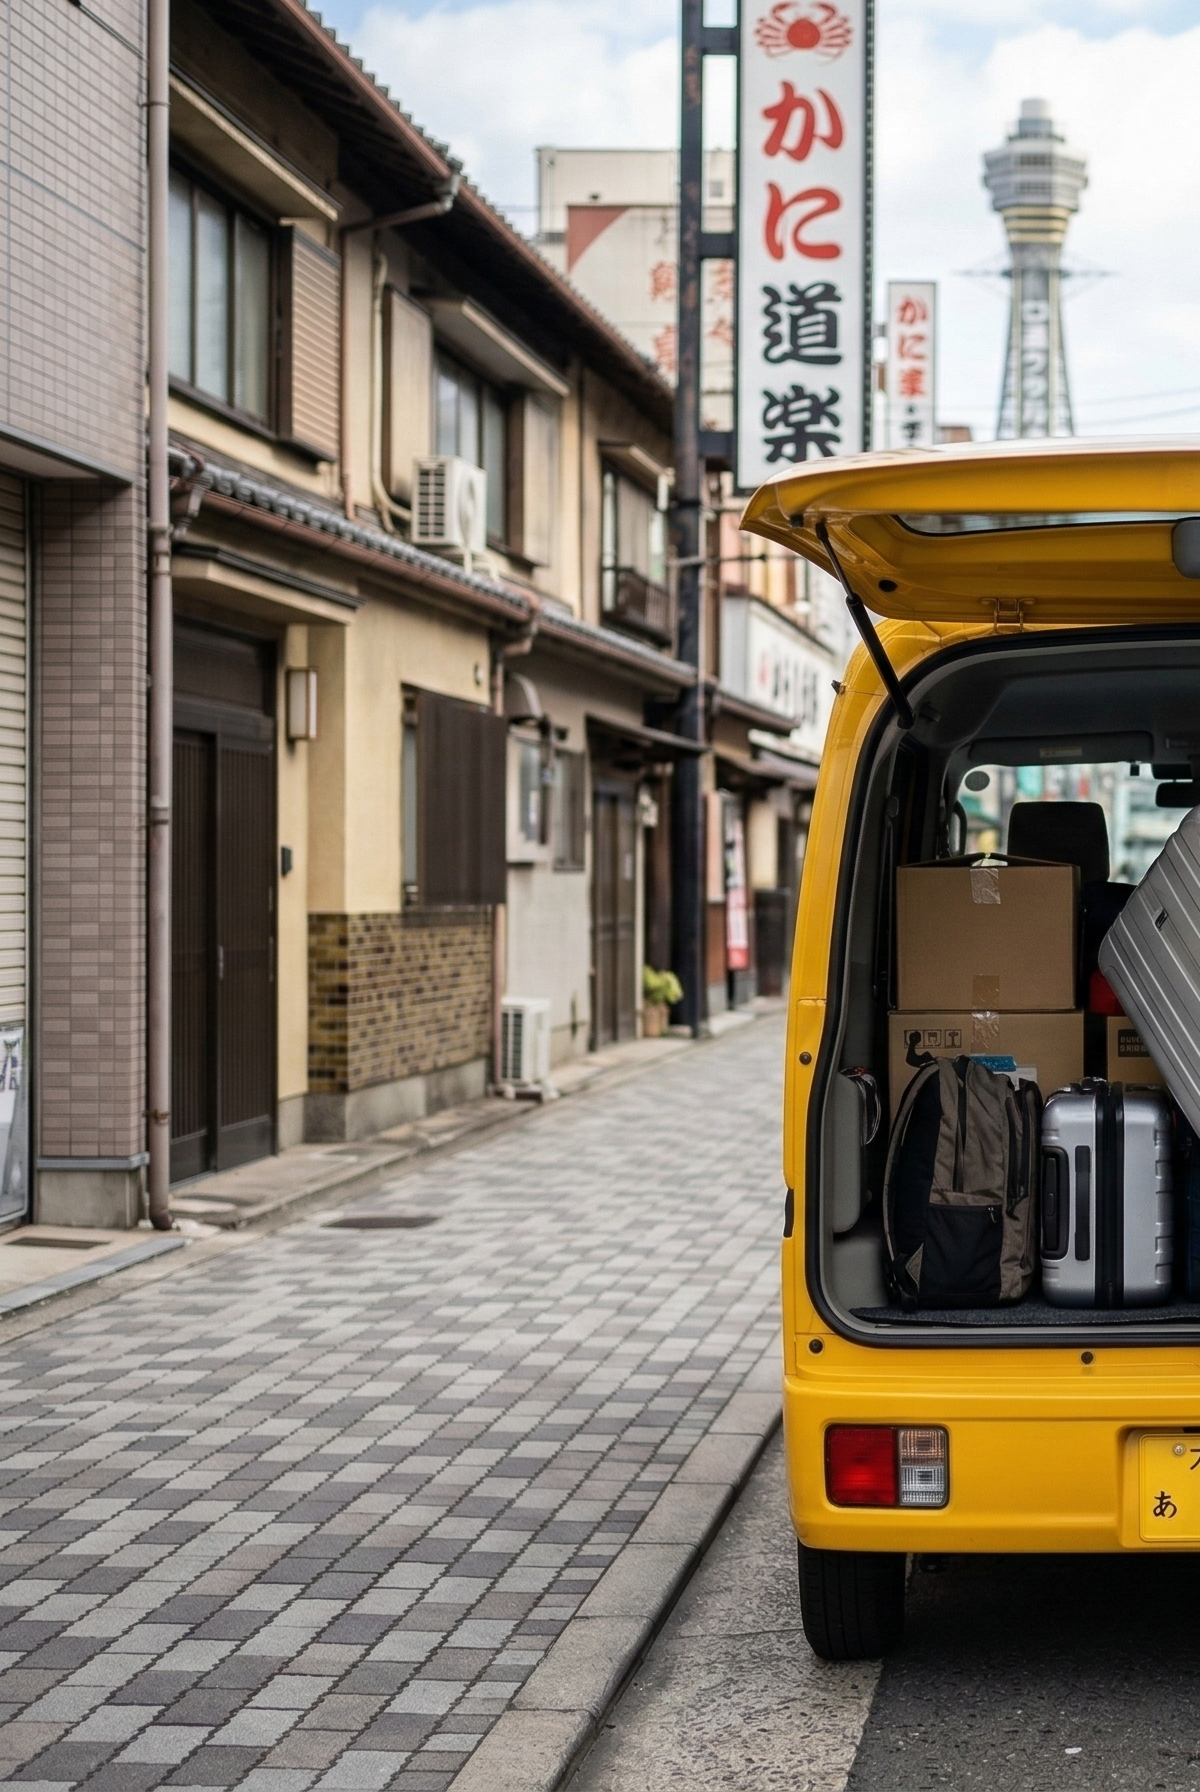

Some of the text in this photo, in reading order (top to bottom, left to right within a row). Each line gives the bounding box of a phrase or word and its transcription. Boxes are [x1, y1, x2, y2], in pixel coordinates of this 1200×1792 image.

[761, 80, 844, 464] かに道楽
[1152, 1490, 1178, 1519] あ
